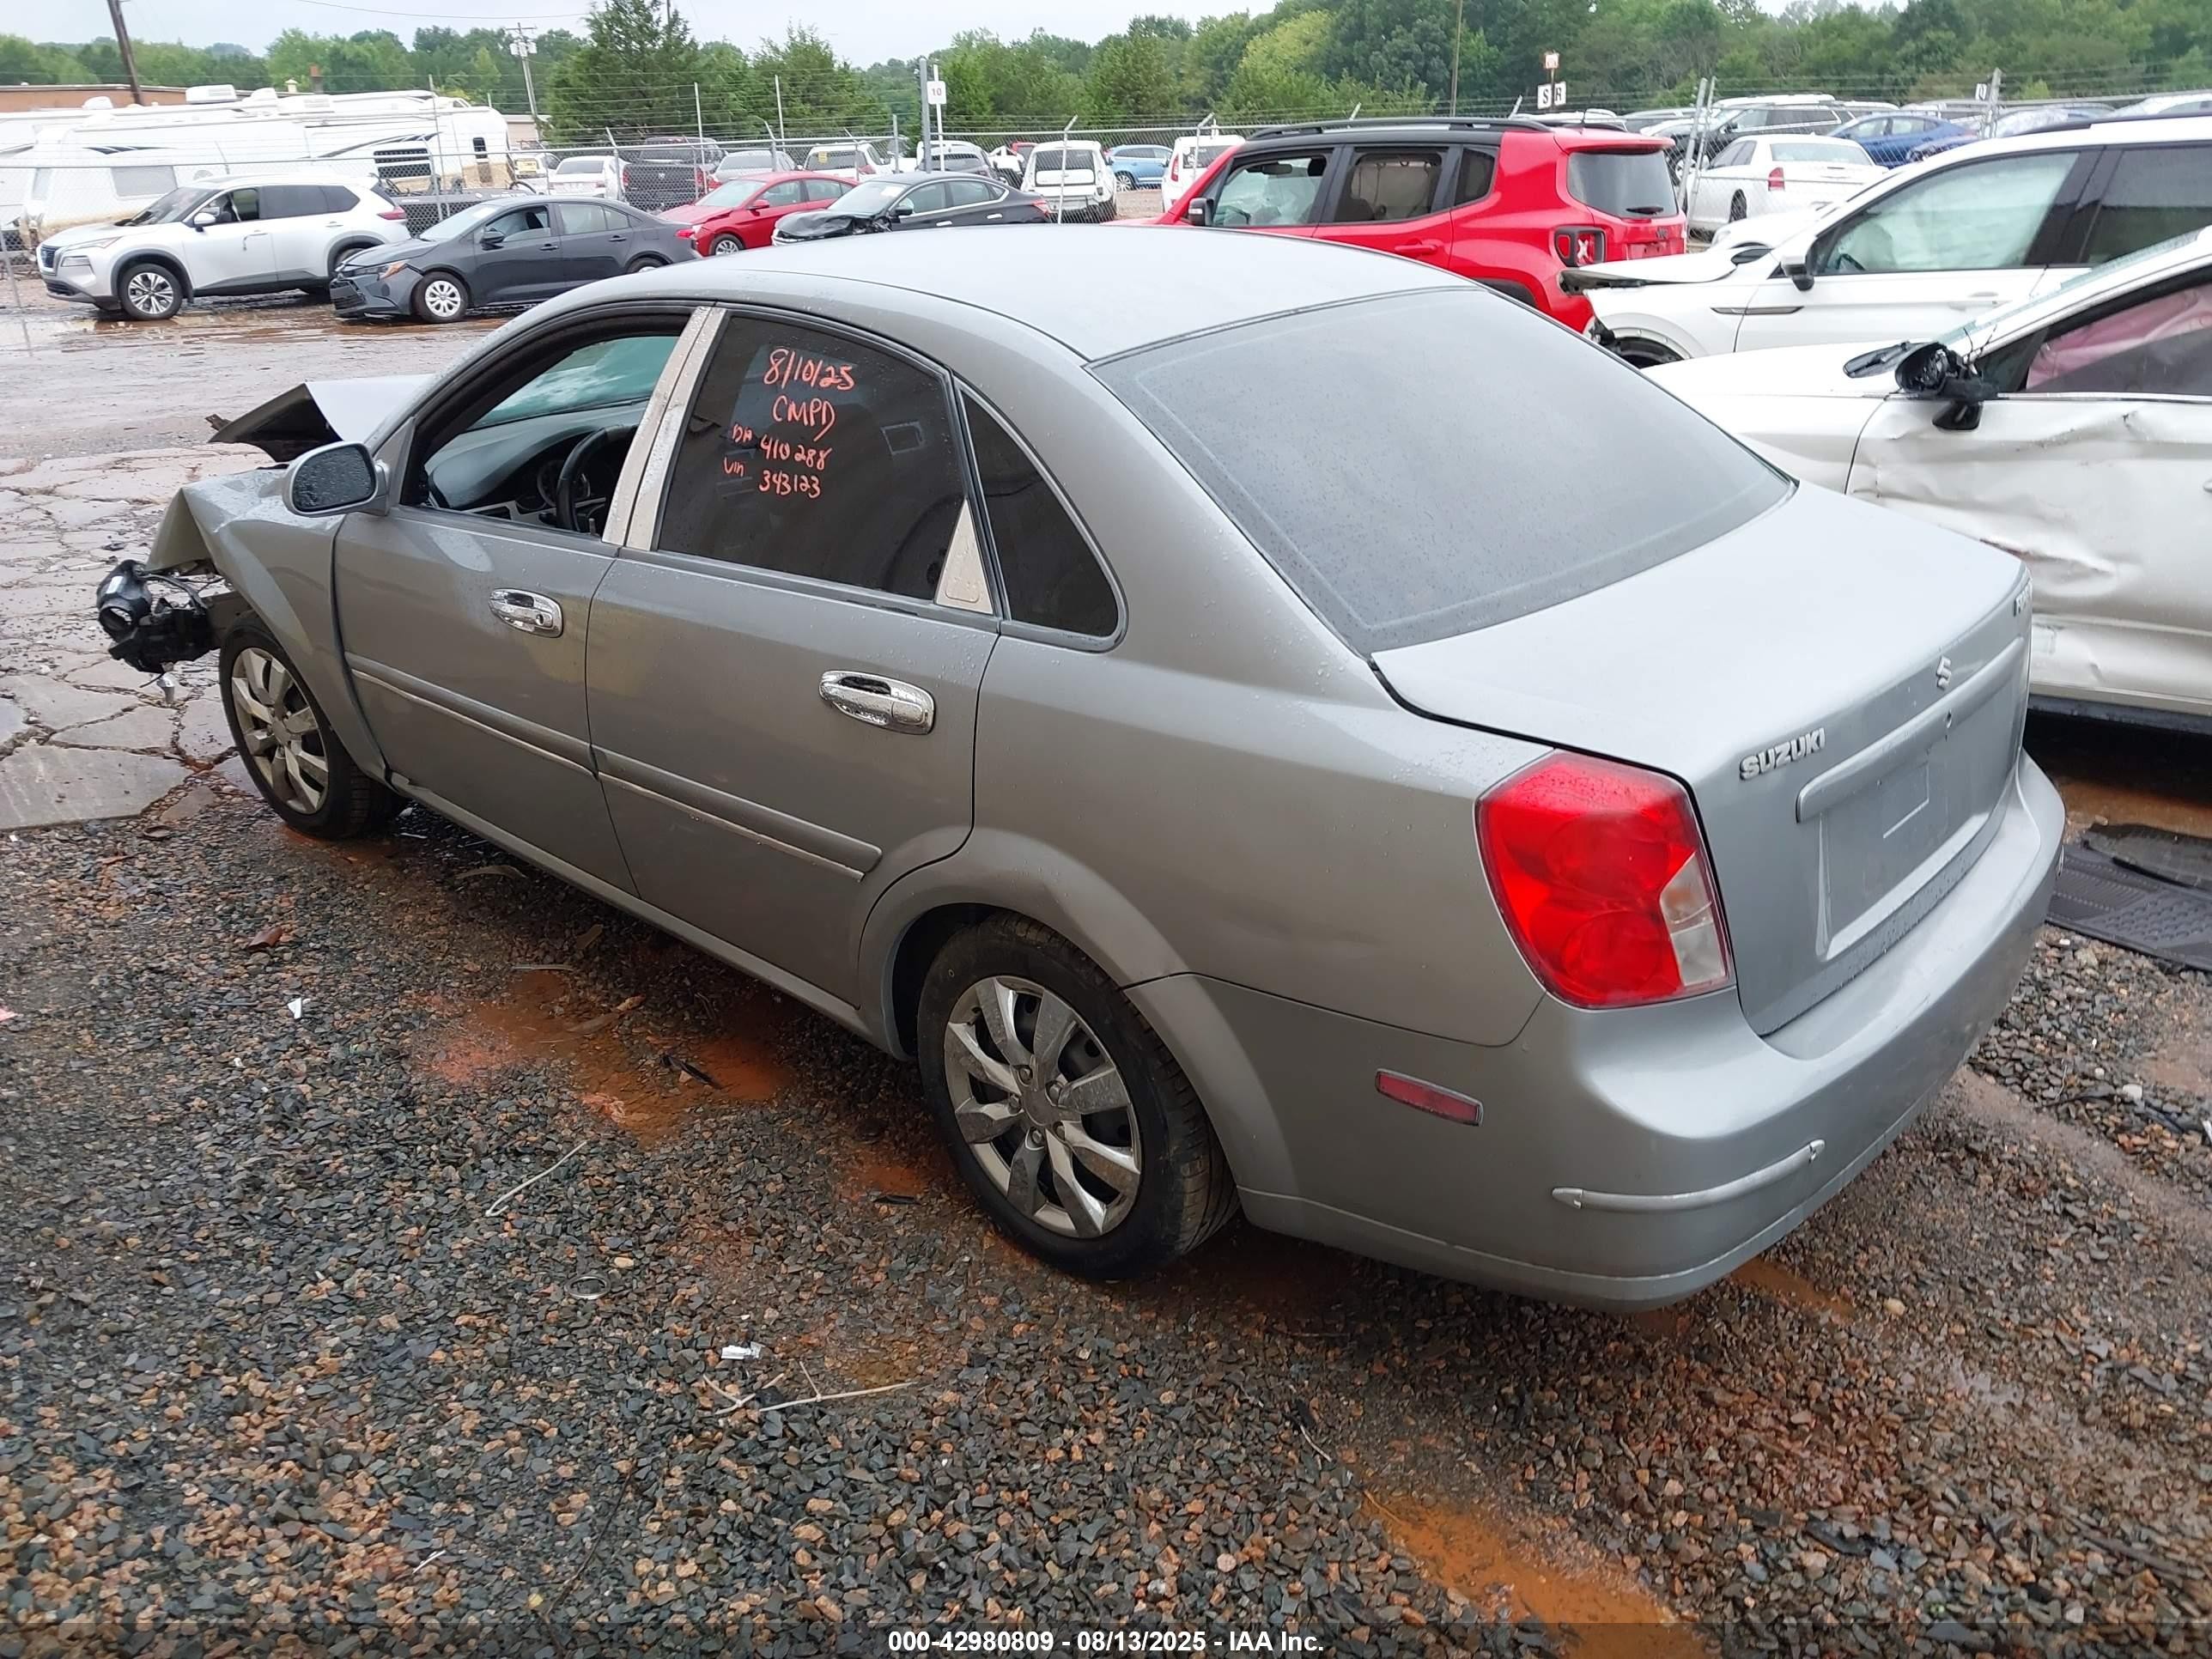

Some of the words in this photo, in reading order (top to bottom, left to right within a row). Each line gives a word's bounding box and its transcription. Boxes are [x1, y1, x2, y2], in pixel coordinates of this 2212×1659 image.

[932, 88, 942, 96] 10
[1542, 88, 1549, 105] S
[1555, 87, 1562, 101] R
[763, 347, 855, 391] 8/10/25
[773, 395, 836, 441] CMPD
[759, 470, 821, 499] 343123
[1739, 727, 1826, 781] SUZUKI
